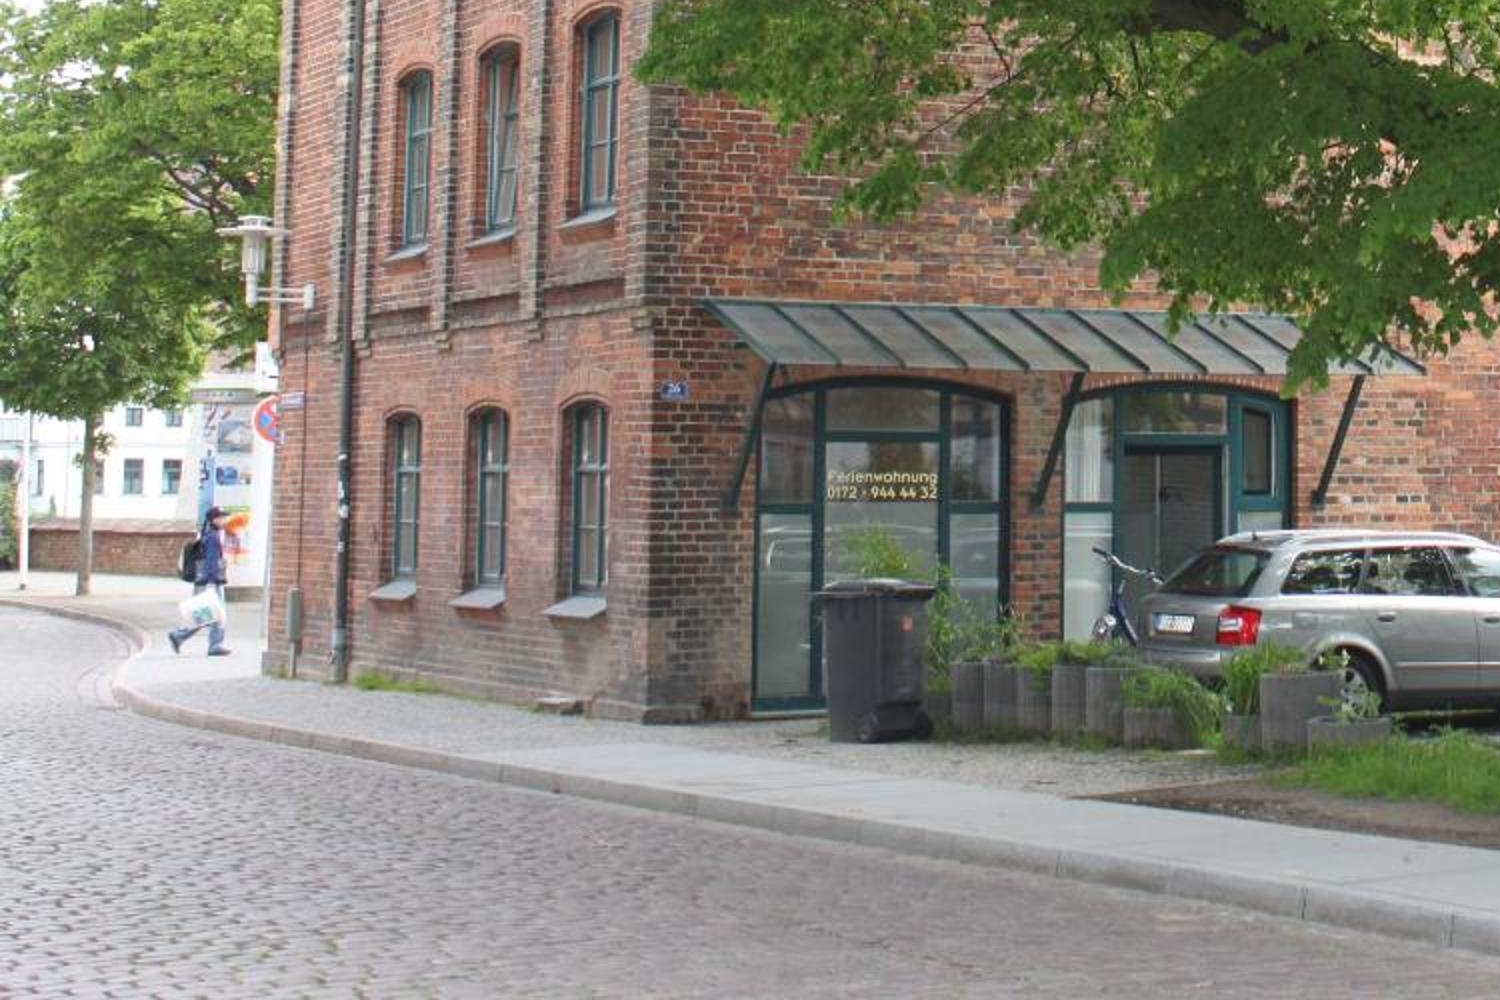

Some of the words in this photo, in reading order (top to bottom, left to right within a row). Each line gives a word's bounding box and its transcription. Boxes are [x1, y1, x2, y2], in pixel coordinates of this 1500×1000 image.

[828, 471, 938, 488] Ferienwohnung
[827, 486, 857, 499] 0172
[872, 486, 897, 499] 944
[899, 486, 917, 499] 44
[919, 486, 937, 499] 32
